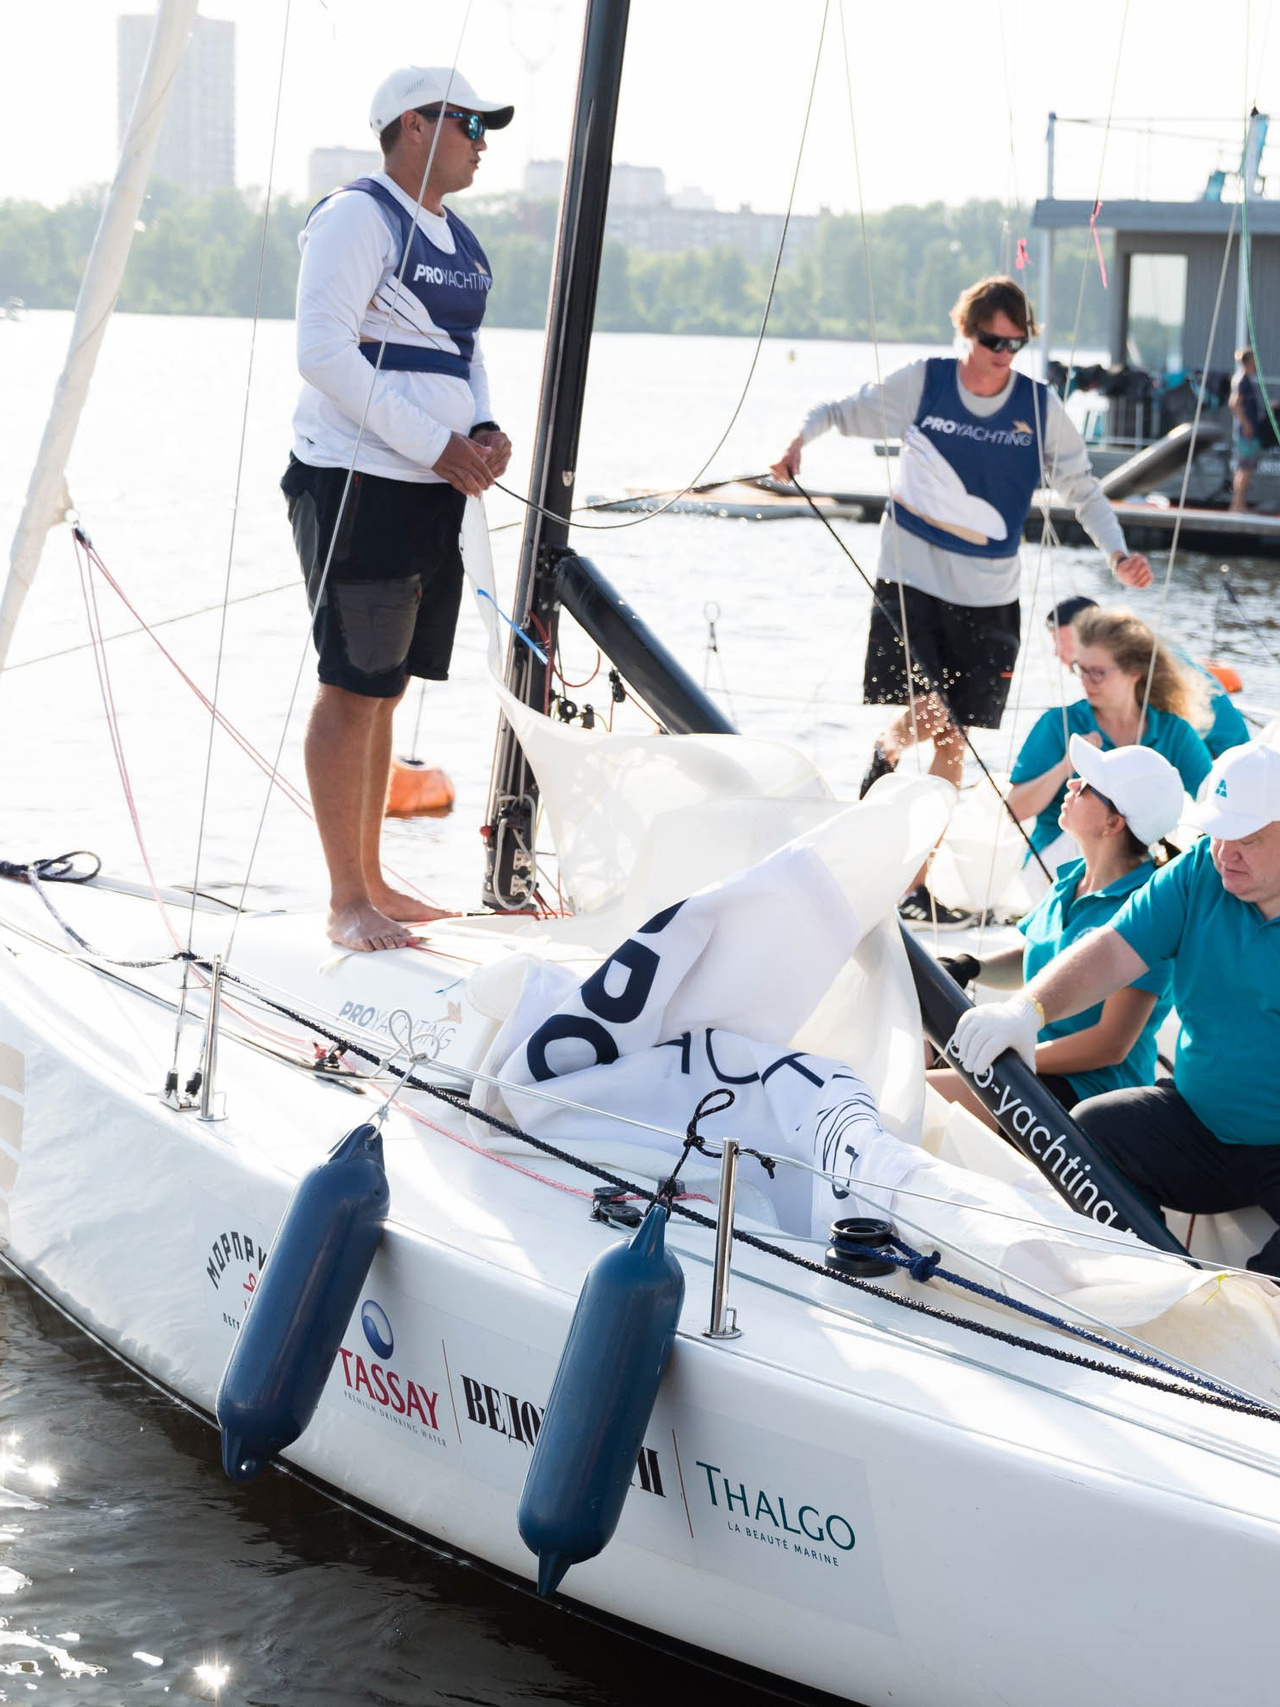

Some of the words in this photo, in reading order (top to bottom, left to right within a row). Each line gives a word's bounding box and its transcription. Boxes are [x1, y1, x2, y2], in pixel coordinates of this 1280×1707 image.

[920, 415, 1033, 446] PROYACHTING
[338, 1346, 440, 1431] TASSAY
[343, 1389, 377, 1412] PREMIUM
[379, 1408, 418, 1434] DRINKING
[420, 1429, 447, 1448] WATER
[695, 1460, 856, 1551] THALGO
[727, 1520, 741, 1534] LA
[745, 1526, 789, 1551] BEAUTÉ
[793, 1543, 839, 1567] MARINE
